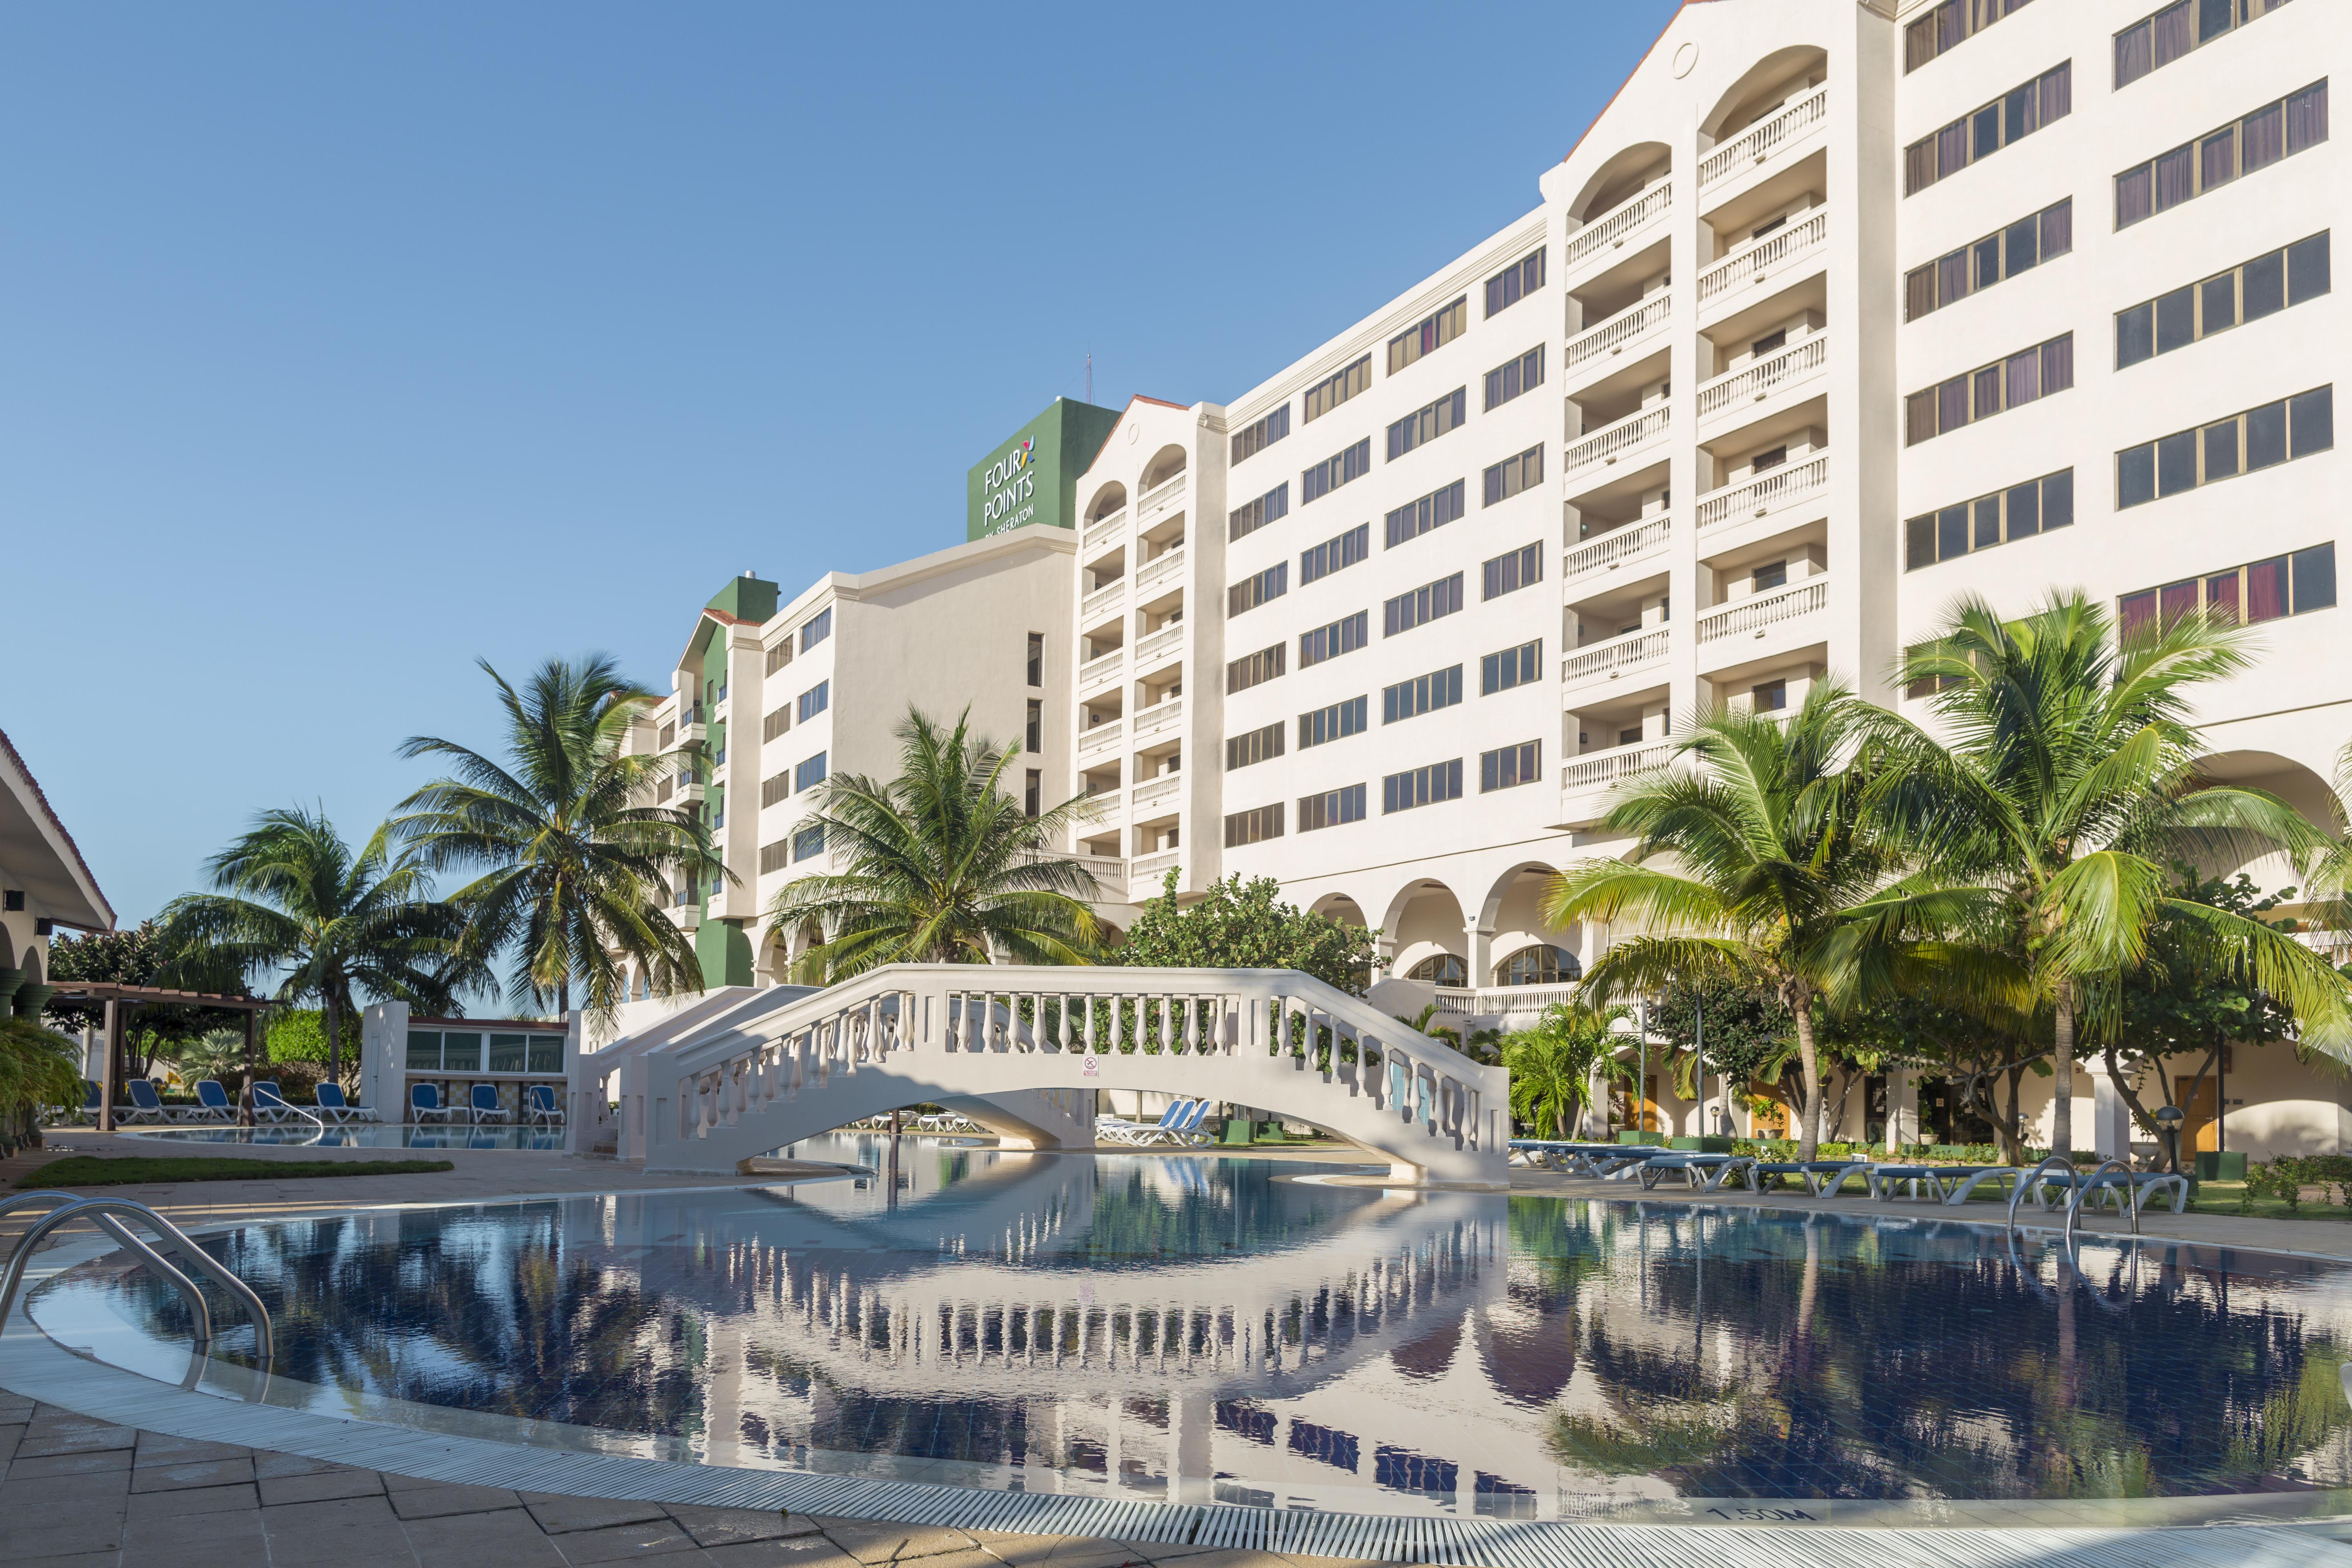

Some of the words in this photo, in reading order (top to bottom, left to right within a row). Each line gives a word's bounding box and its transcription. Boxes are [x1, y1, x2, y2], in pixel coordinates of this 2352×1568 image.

[985, 449, 1022, 495] FOUR
[984, 471, 1034, 526] POINTS
[997, 503, 1034, 535] SHERATON
[1706, 1508, 1817, 1521] 1.50M
